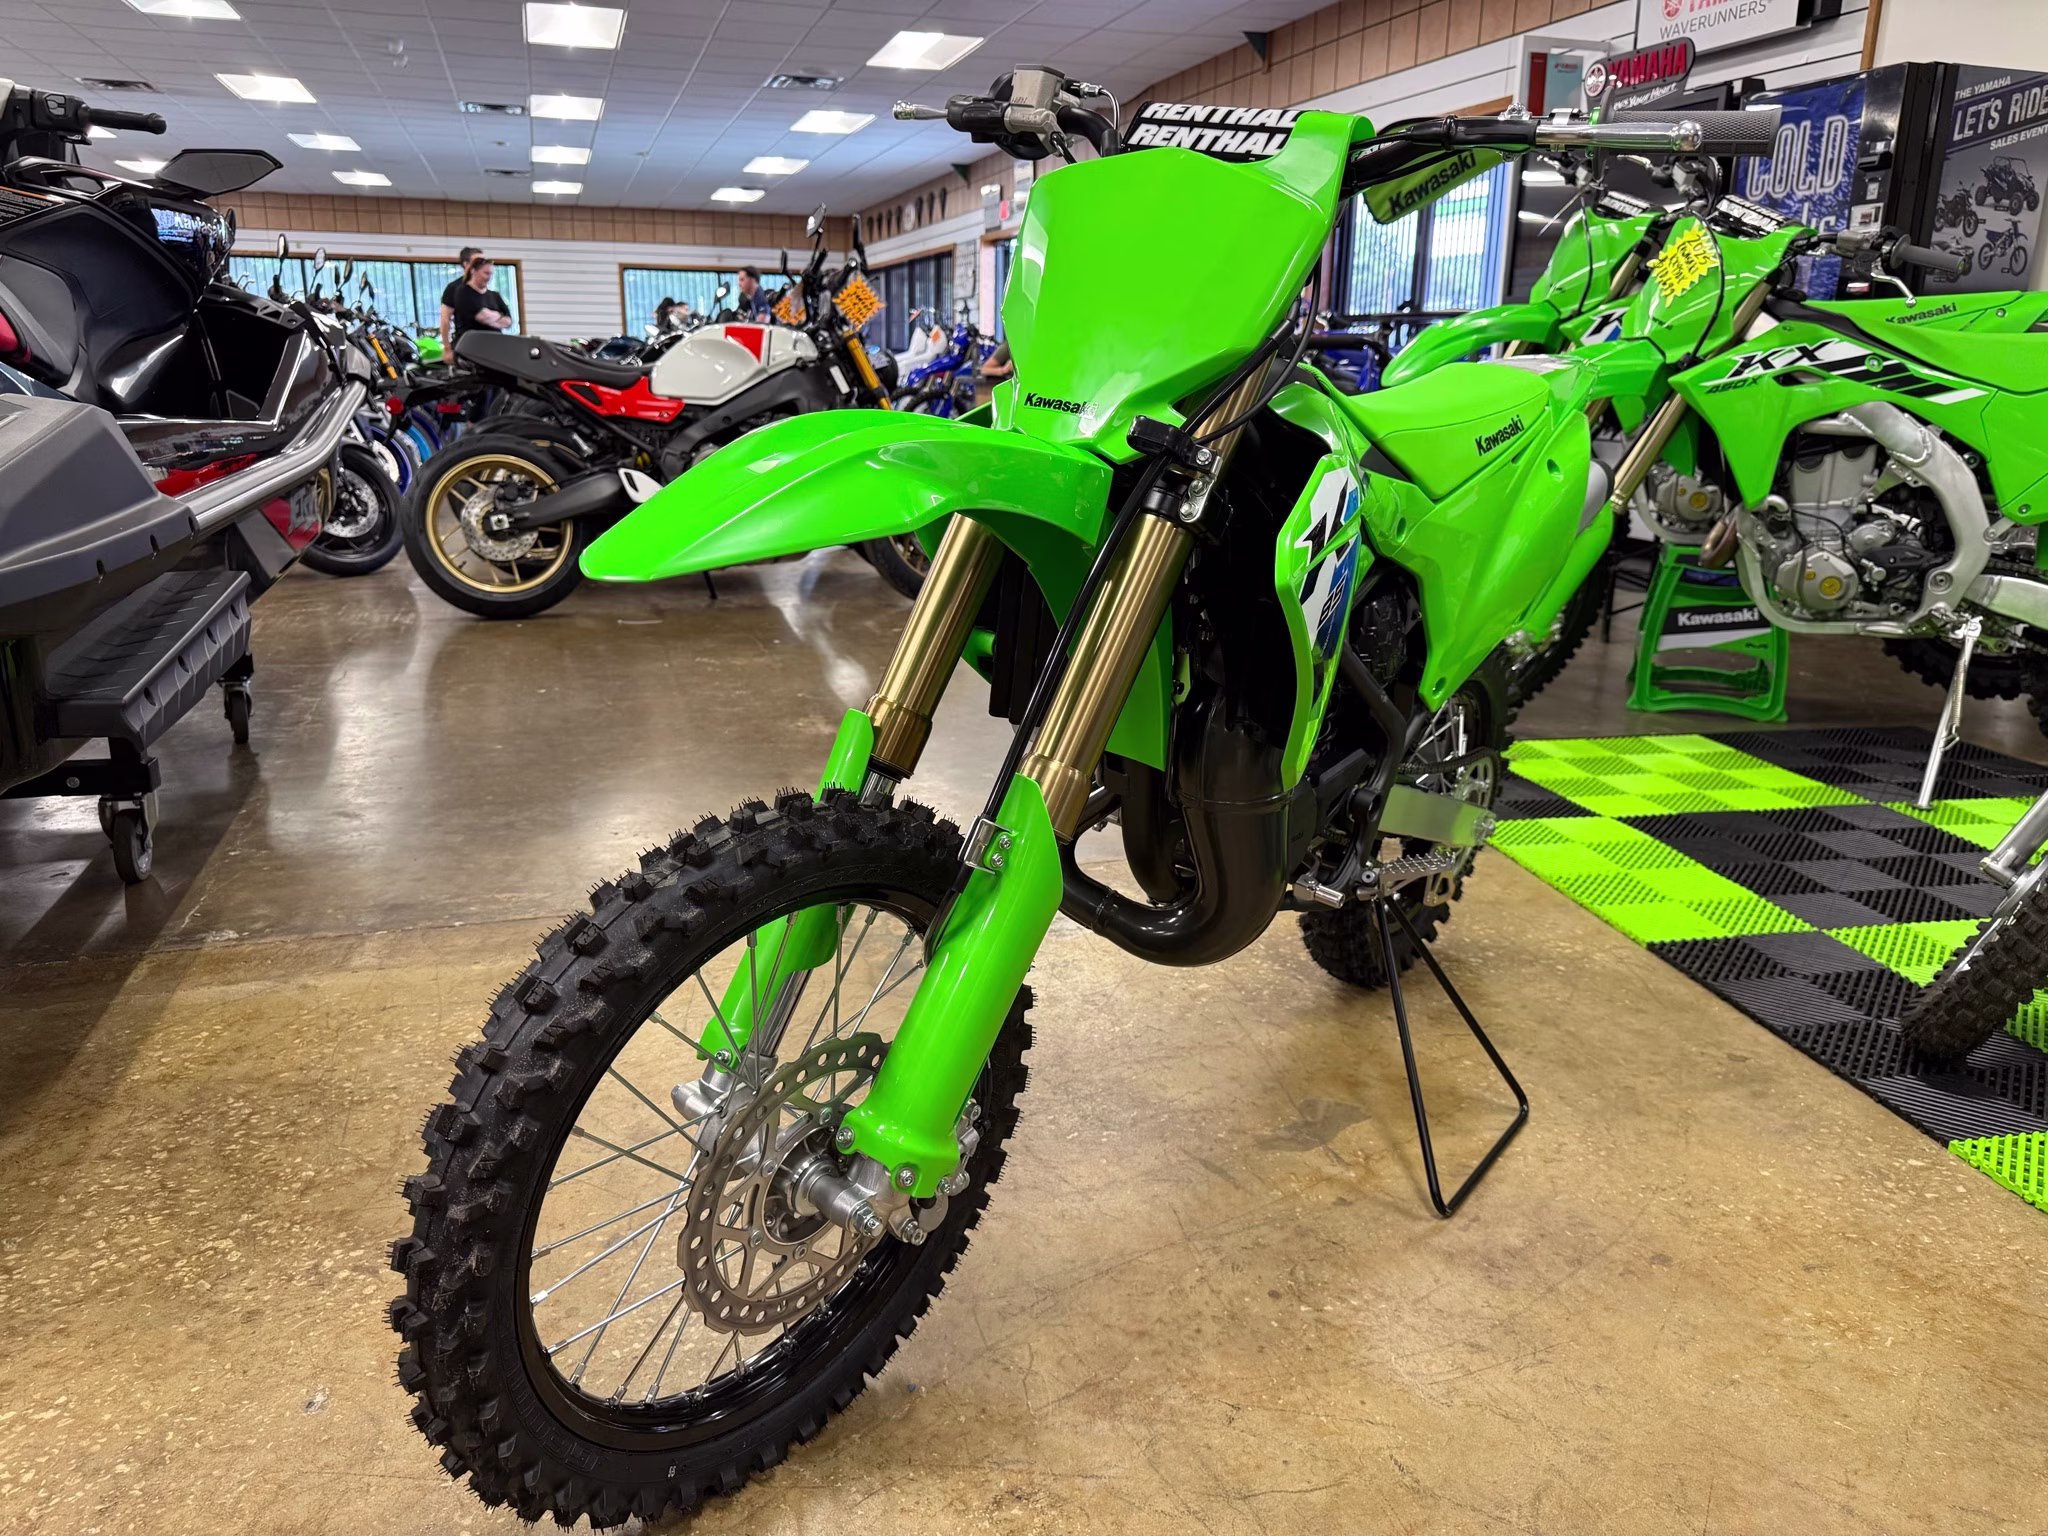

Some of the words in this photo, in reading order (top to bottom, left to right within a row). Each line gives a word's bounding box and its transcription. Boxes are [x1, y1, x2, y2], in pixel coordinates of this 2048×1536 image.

[1660, 1, 1767, 40] WAVERUNNERS
[1608, 43, 1687, 88] YAMAHA
[1955, 88, 1973, 101] THE
[1974, 76, 2011, 95] YAMAHA
[1141, 102, 1301, 128] RENTHAL
[1953, 98, 2003, 142] LET'S
[2008, 84, 2048, 125] RIDE
[1127, 123, 1288, 156] RENTHAL
[1990, 133, 2018, 151] SALES
[2019, 123, 2048, 142] EVENT
[1746, 115, 1848, 200] COLD
[1388, 151, 1476, 216] Kawasaki
[1686, 234, 1711, 265] 2025
[1727, 339, 1839, 379] KX
[1475, 414, 1525, 457] Kawasaki
[1677, 607, 1760, 627] Kawasaki
